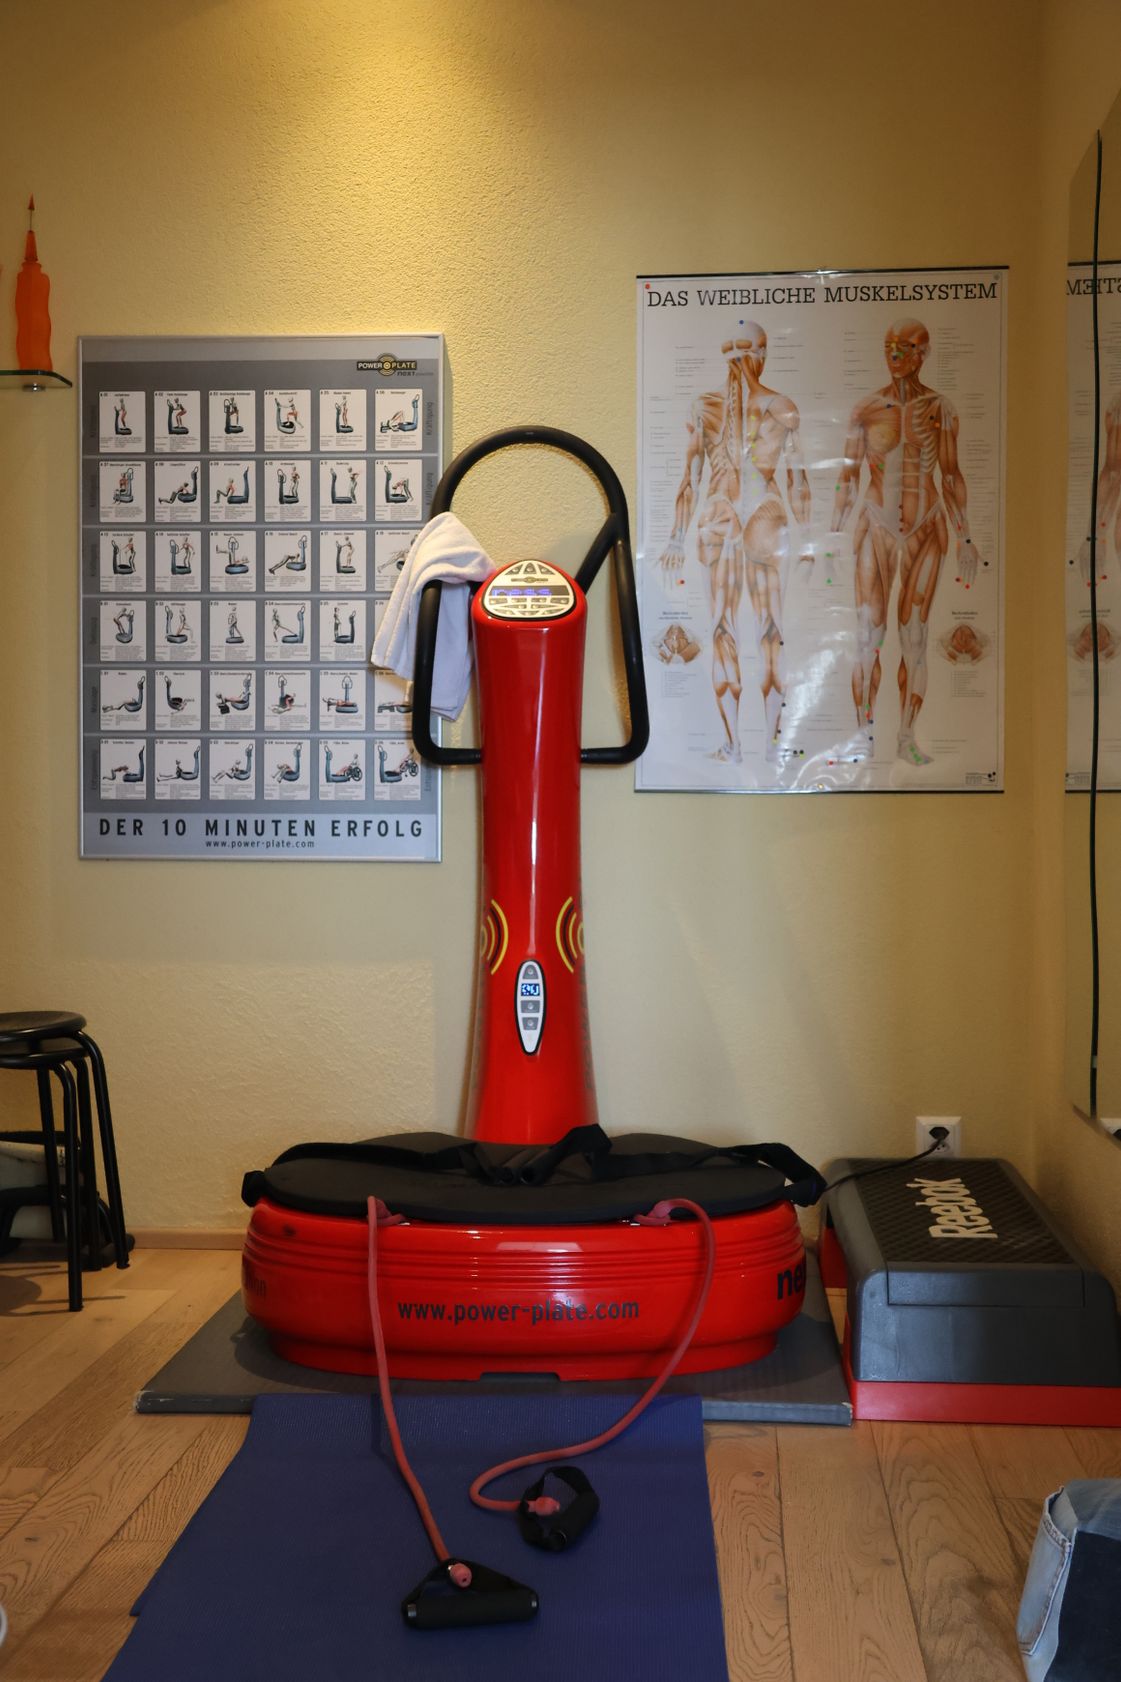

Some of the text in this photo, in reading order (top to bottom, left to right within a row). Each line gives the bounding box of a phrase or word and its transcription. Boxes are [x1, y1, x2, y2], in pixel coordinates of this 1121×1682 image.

[647, 282, 998, 307] DAS WEIBLICHE MUSKELSYSTEM
[391, 361, 416, 369] PLATE
[99, 818, 422, 838] DER 10 MINUTEN ERFOLG
[205, 839, 315, 849] www.power-plate.com
[905, 1177, 999, 1239] Reebok
[397, 1299, 640, 1326] www.power-plate.com
